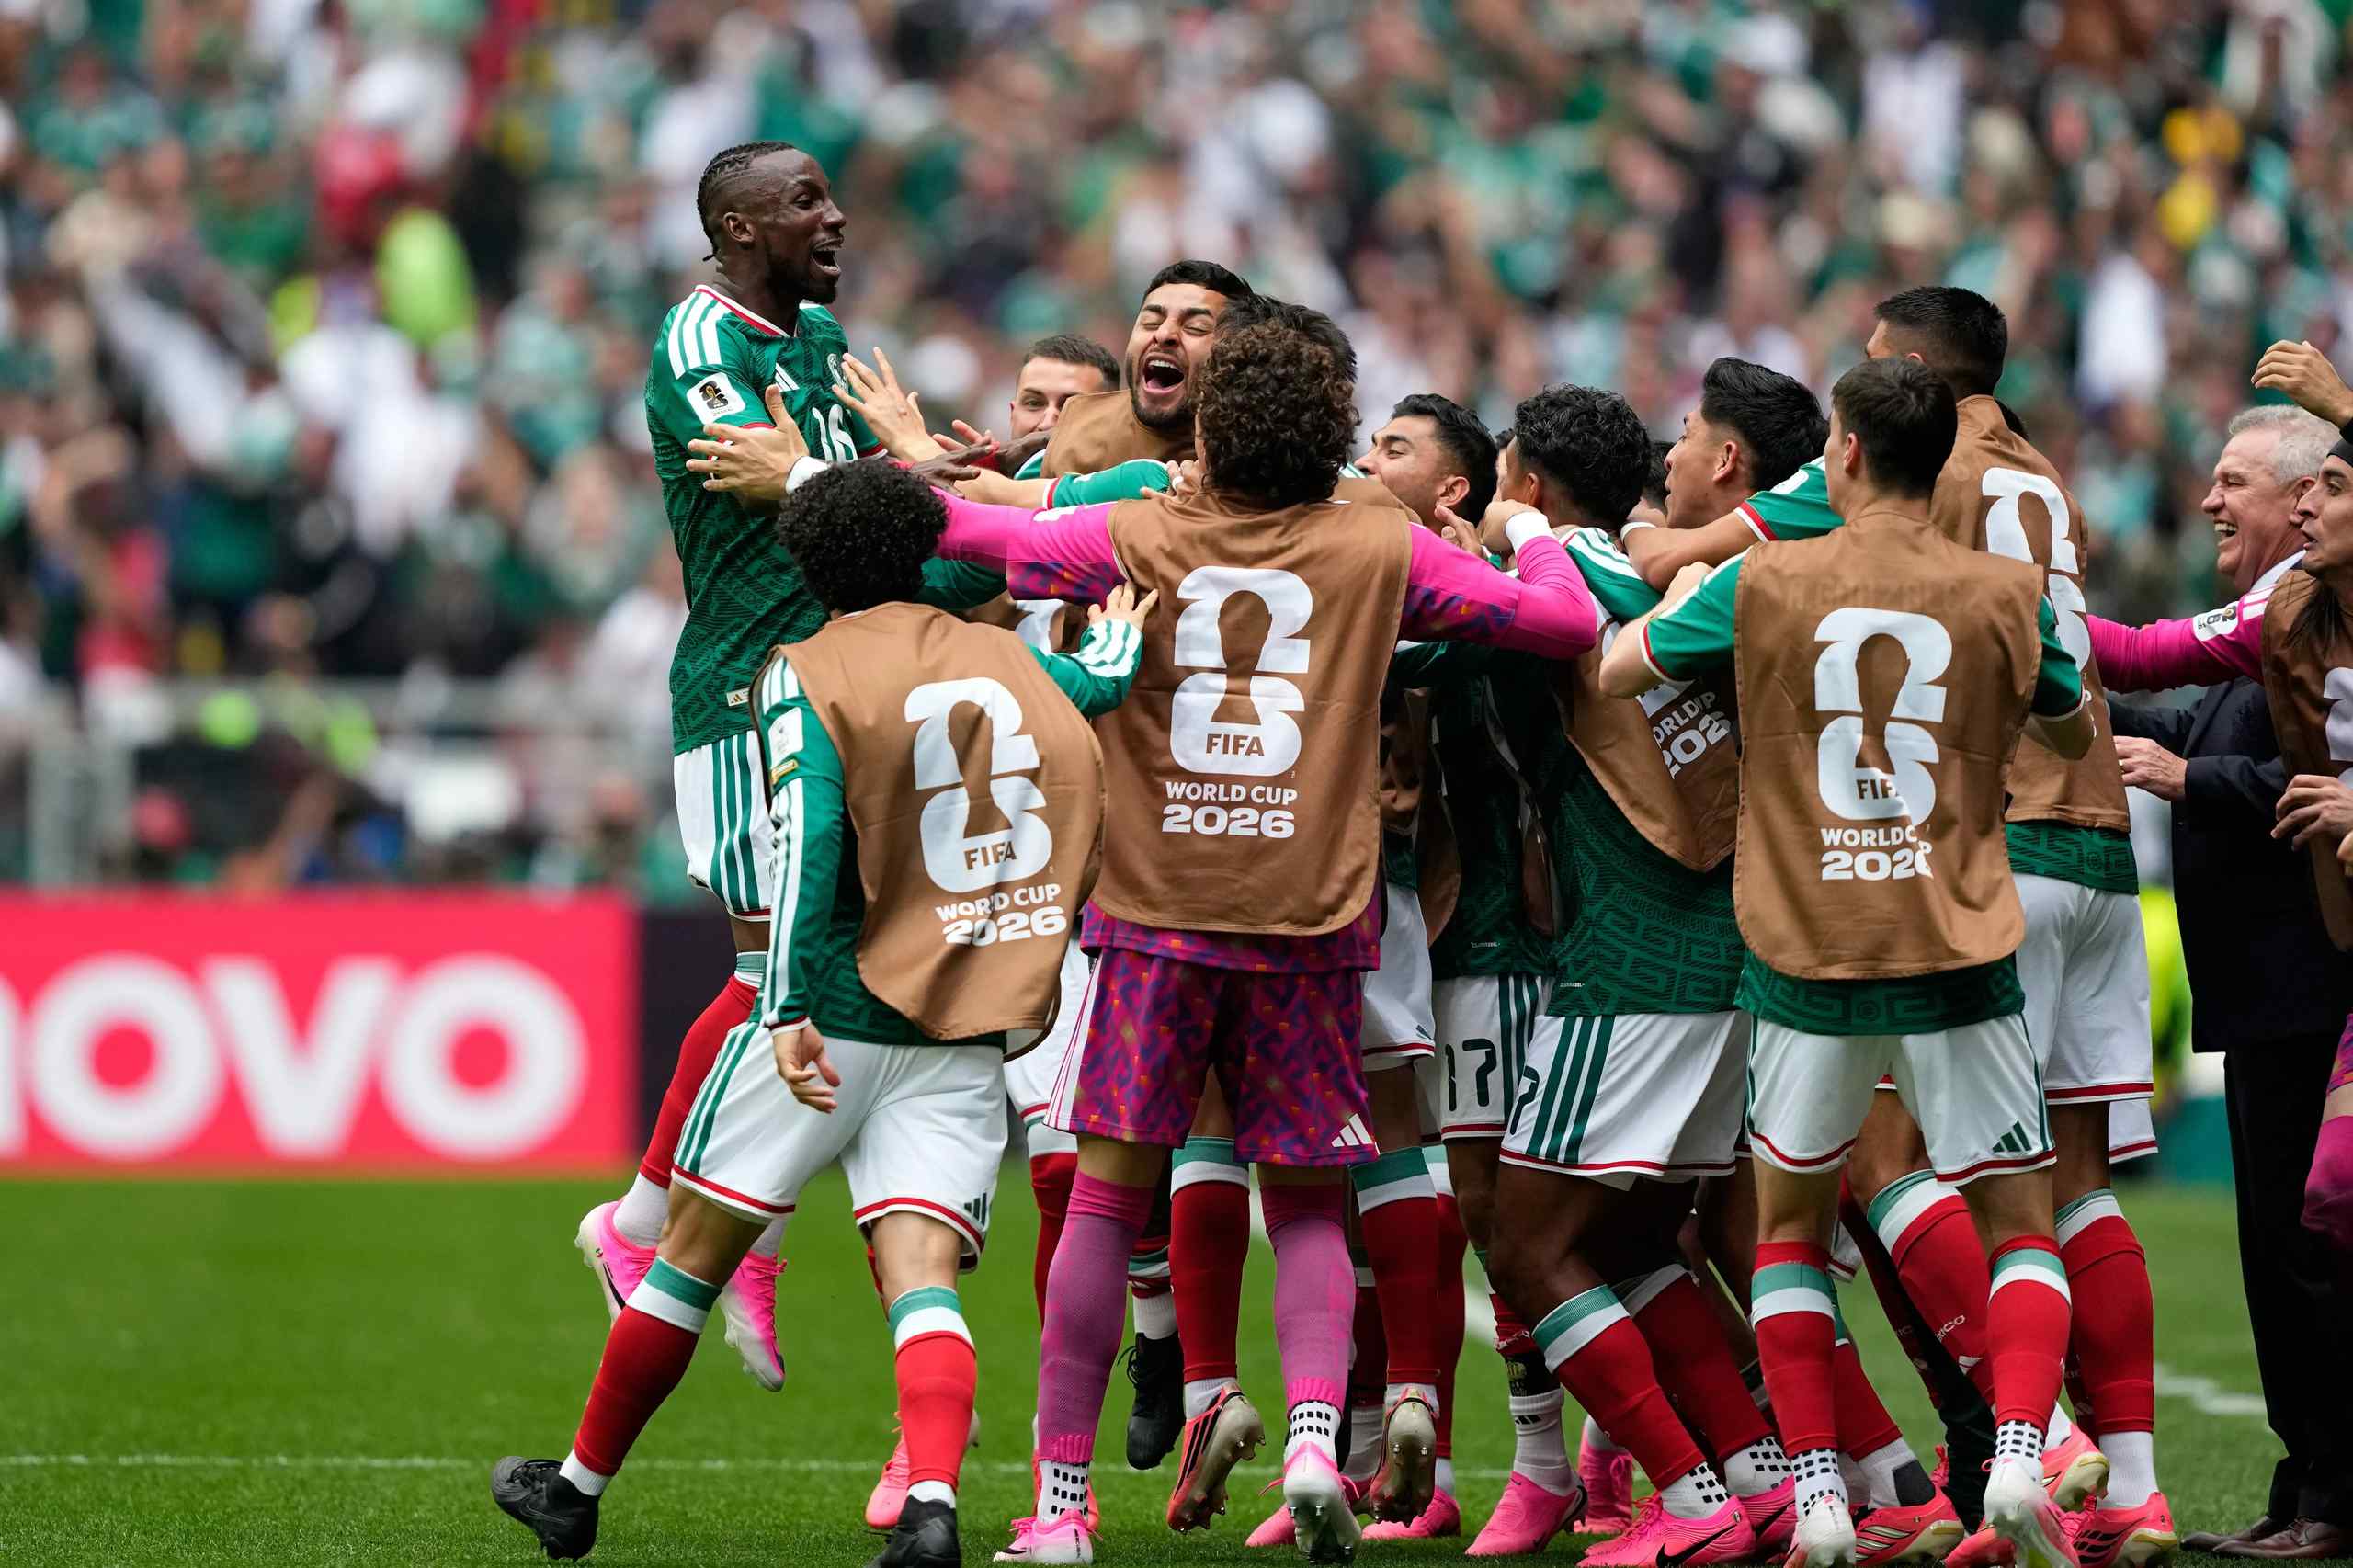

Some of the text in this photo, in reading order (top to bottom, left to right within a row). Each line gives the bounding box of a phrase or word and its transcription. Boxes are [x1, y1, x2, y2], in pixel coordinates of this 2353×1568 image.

[812, 404, 858, 462] 16
[1653, 700, 1700, 750] ORLD
[1205, 733, 1265, 757] FIFA
[1165, 781, 1298, 806] WORLD CUP
[1856, 779, 1899, 800] FIF
[1162, 803, 1295, 839] 2026
[963, 841, 1017, 870] FIFA
[1821, 824, 1933, 854] WORLD CP
[1013, 883, 1062, 905] CUP
[942, 905, 1067, 947] 2026
[0, 949, 590, 1161] ovo
[1445, 1038, 1497, 1112] 17
